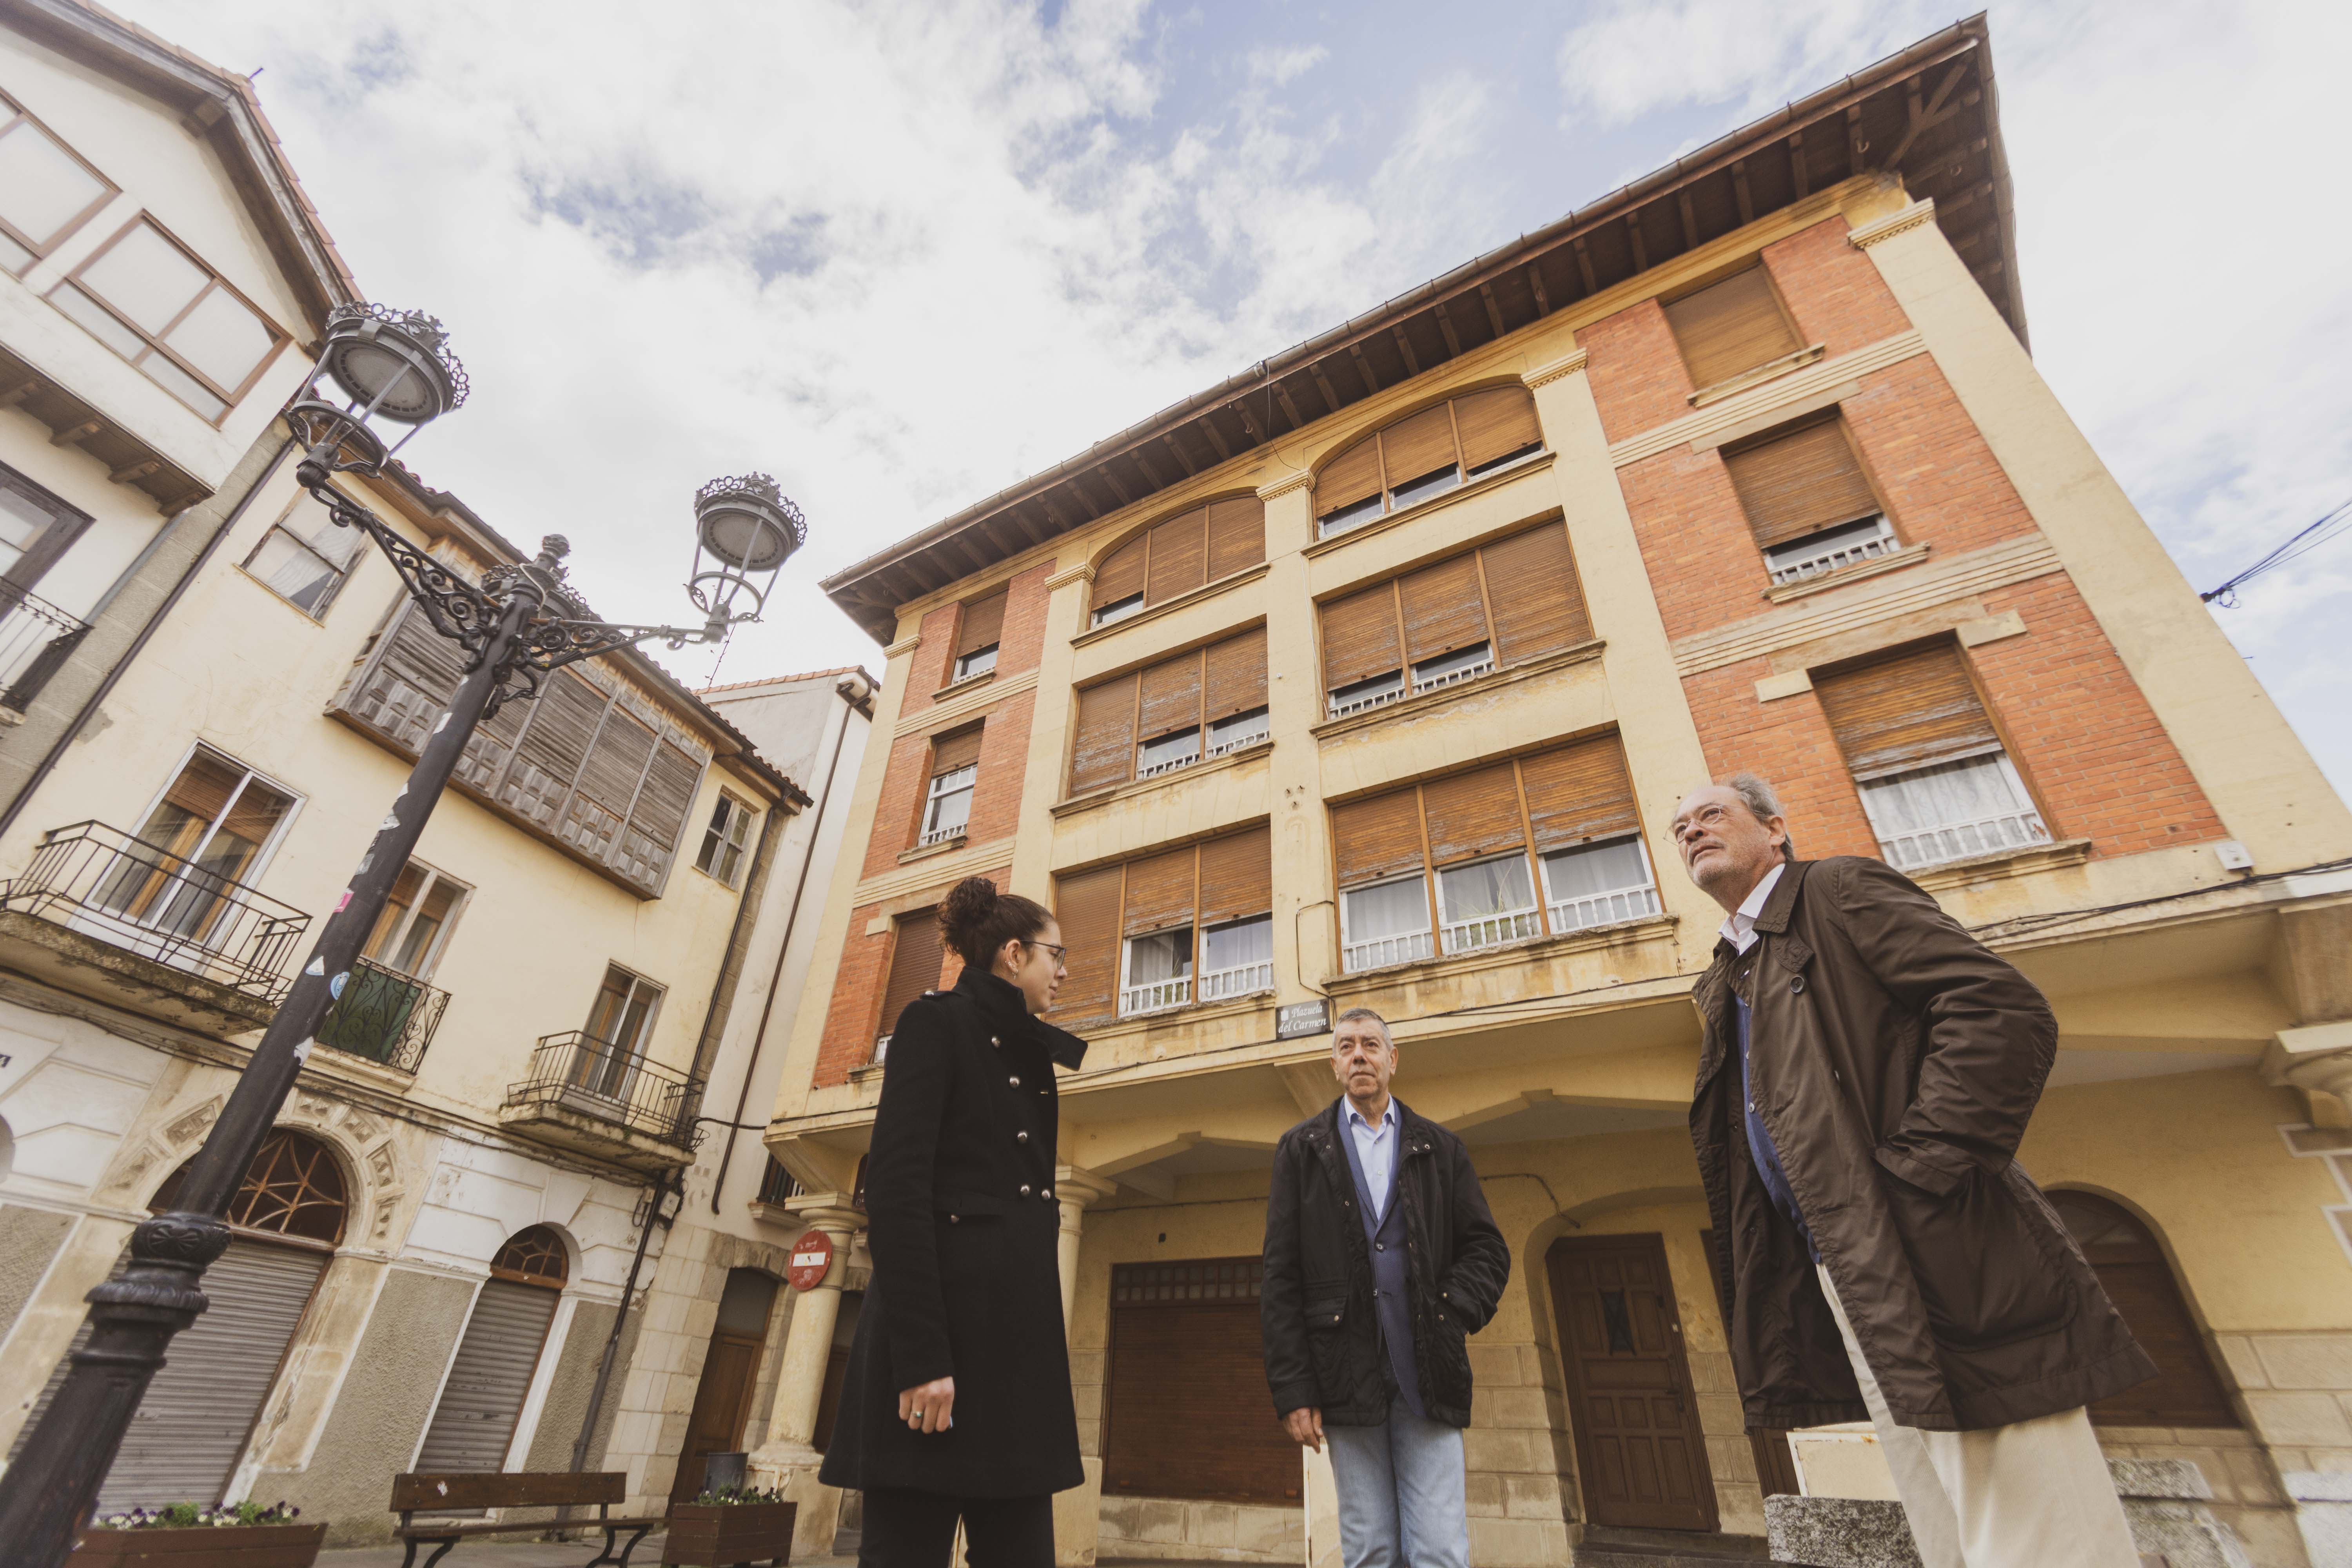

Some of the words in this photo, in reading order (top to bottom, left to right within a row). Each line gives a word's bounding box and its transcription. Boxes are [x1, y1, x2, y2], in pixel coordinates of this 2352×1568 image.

[1292, 1002, 1323, 1018] Plazuela
[1278, 1020, 1293, 1033] del
[1293, 1018, 1327, 1031] Carmen
